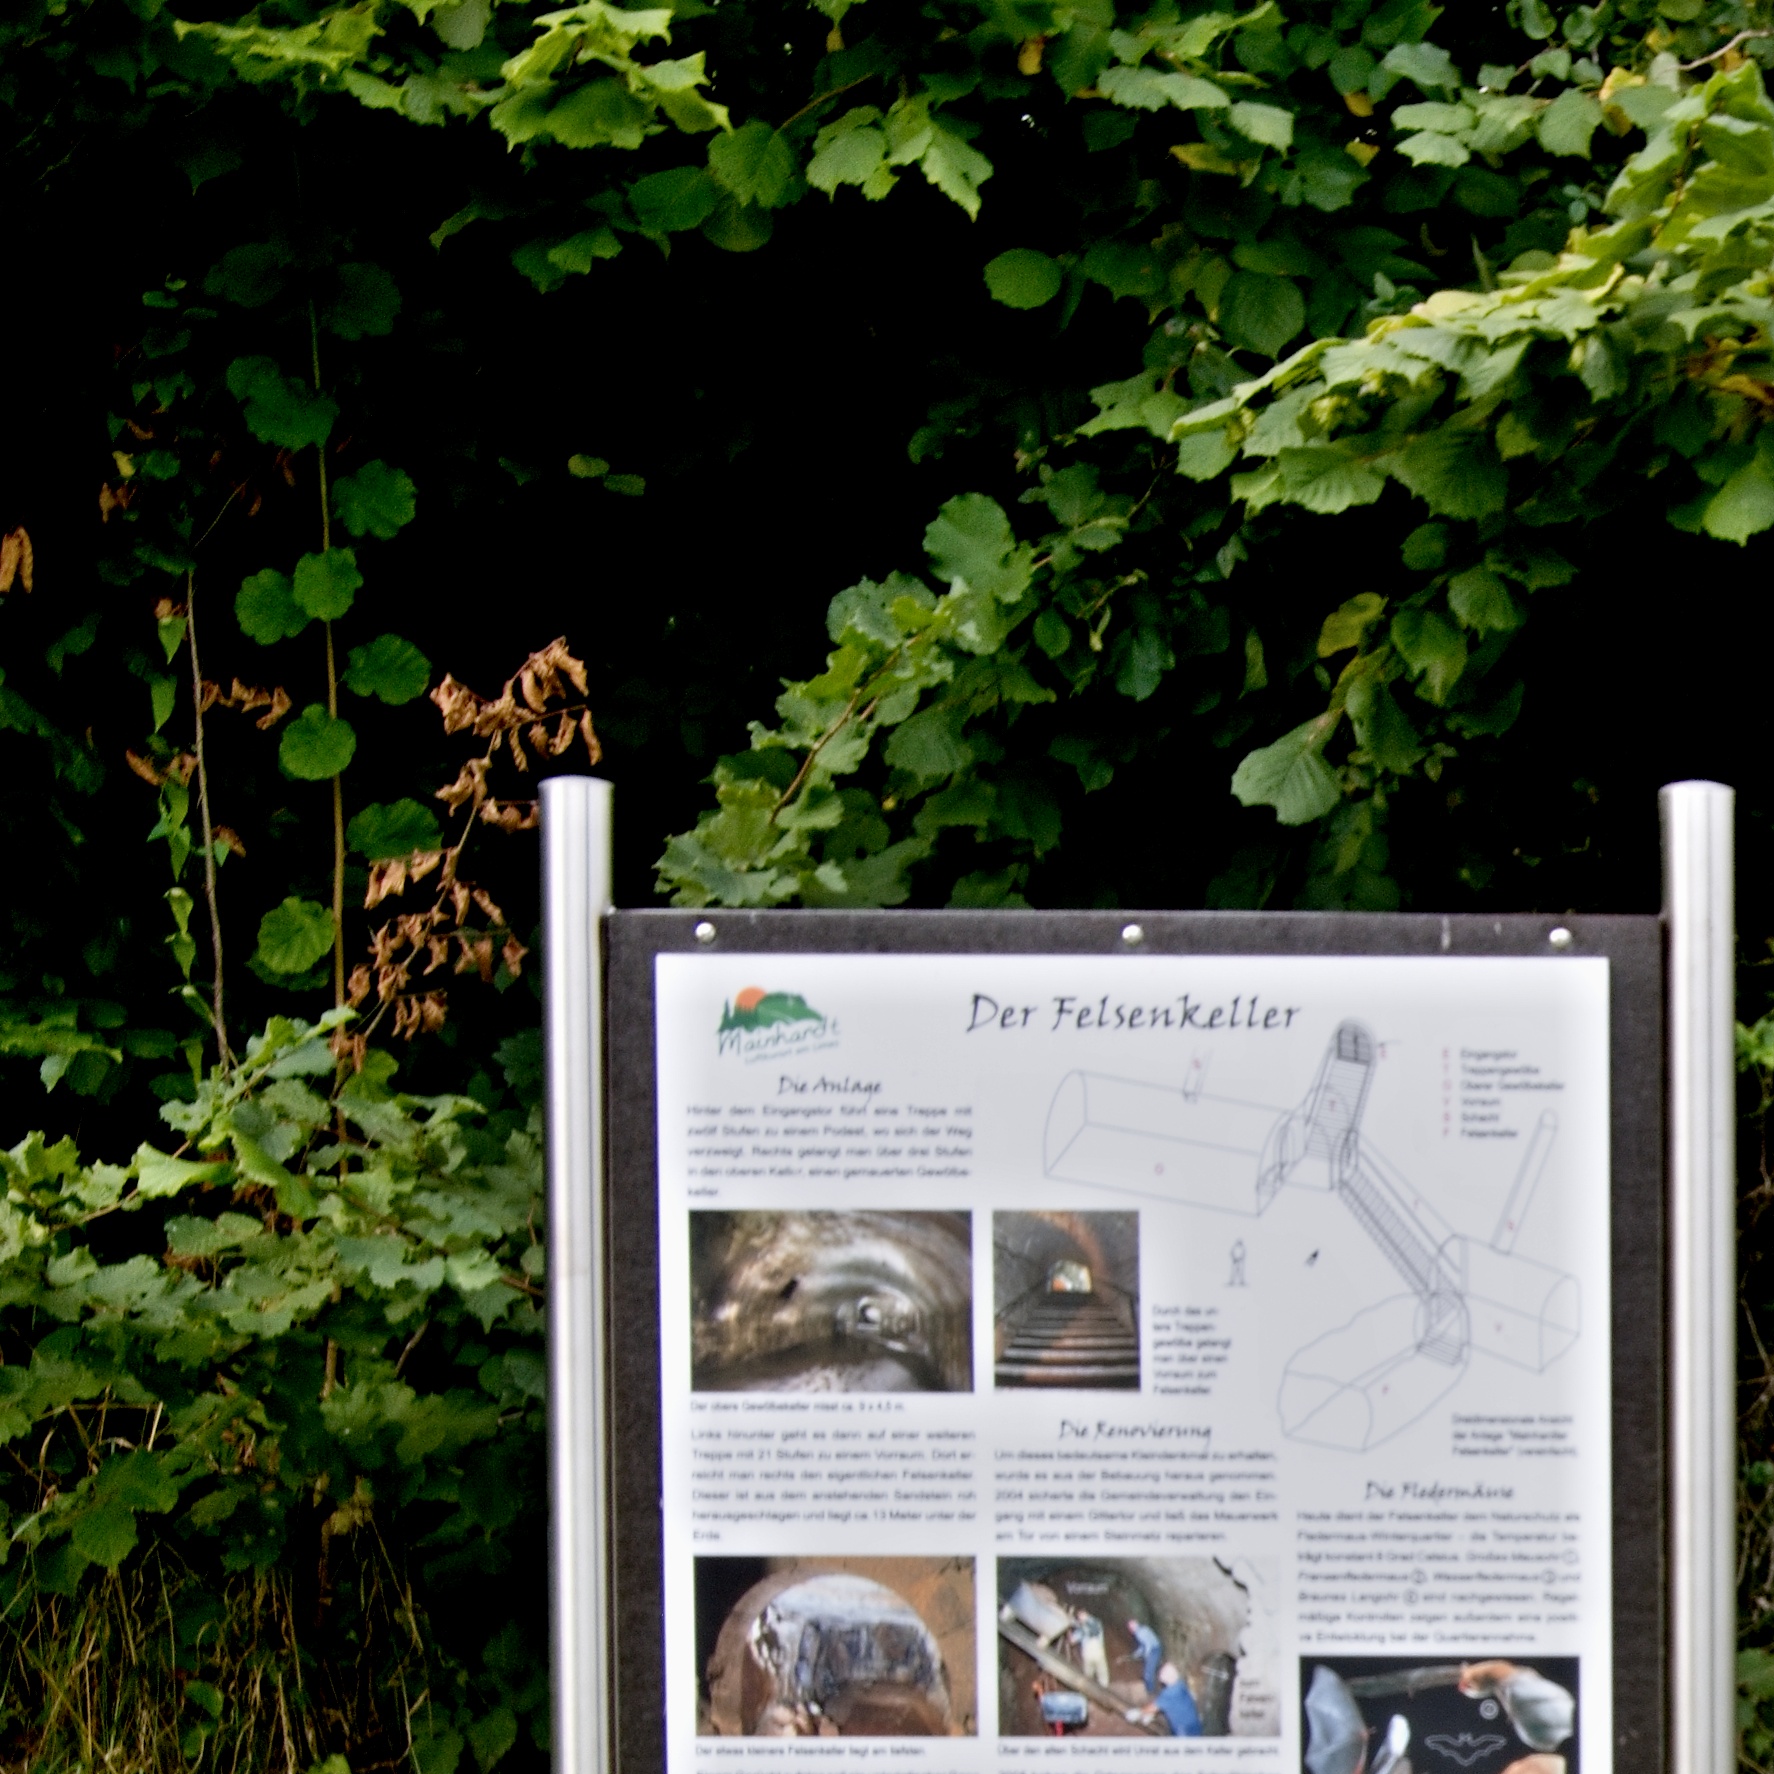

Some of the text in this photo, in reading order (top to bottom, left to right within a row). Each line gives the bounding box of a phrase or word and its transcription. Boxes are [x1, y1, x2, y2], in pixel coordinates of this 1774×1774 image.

[966, 993, 1301, 1032] Der Felsenkeller
[716, 1016, 841, 1056] Mainhardt
[777, 1075, 882, 1110] Die Anlage
[1058, 1420, 1213, 1450] Die Renovierung
[1365, 1480, 1514, 1503] Die Fledermäuse
